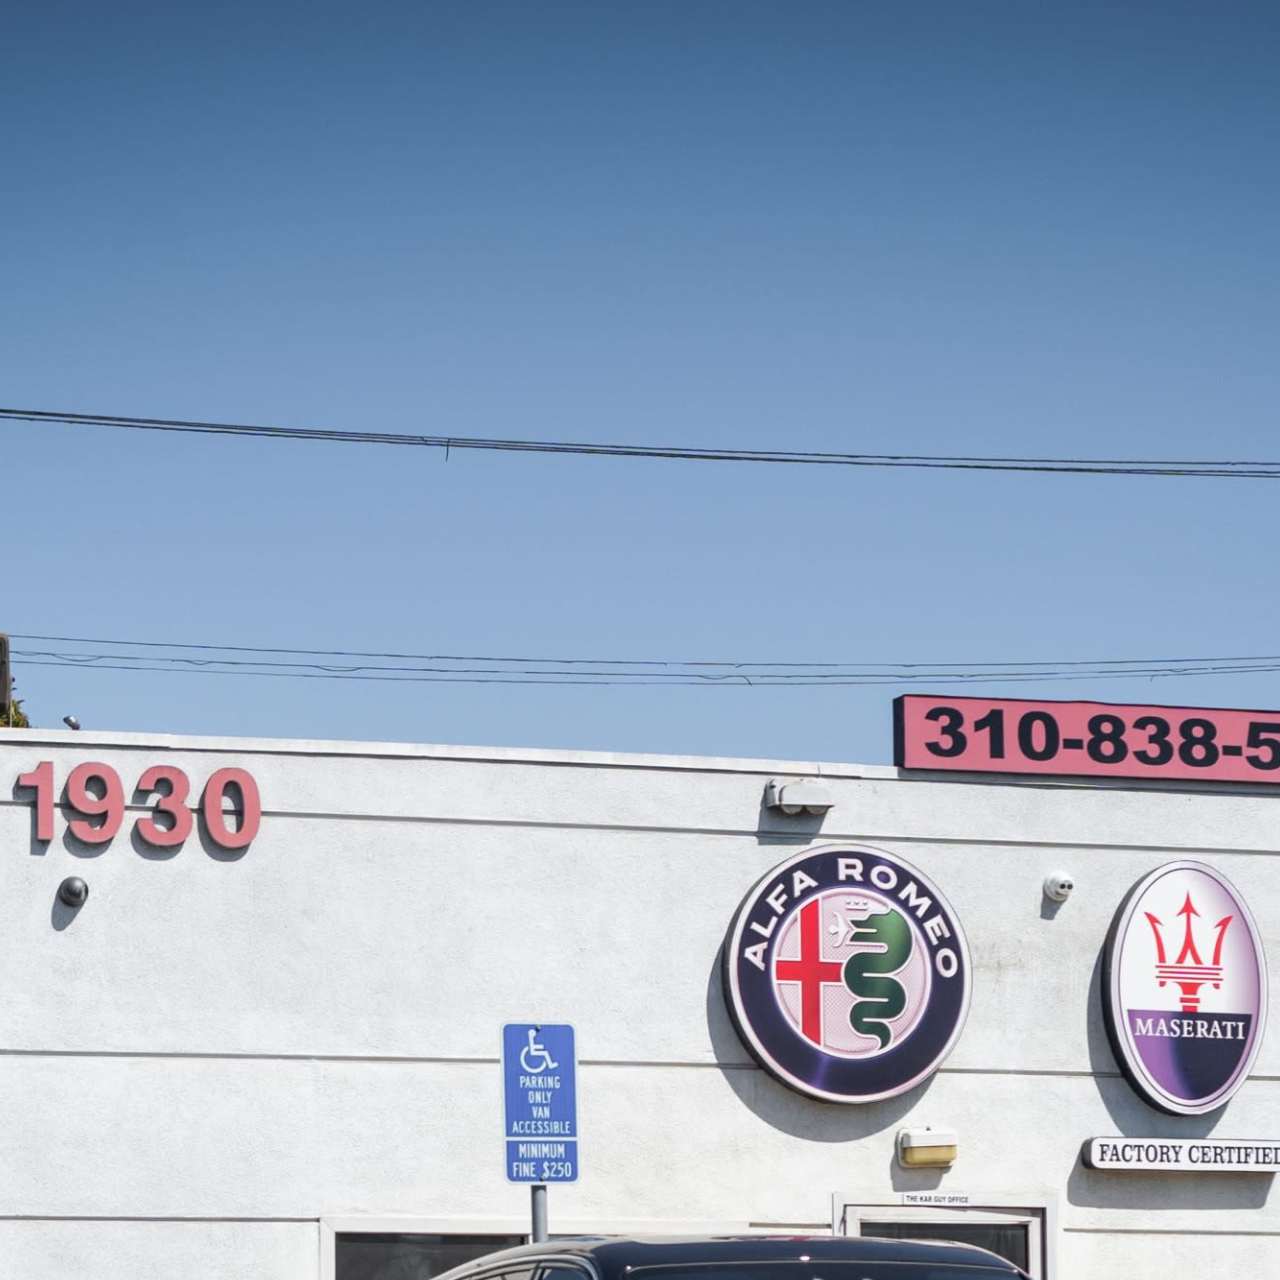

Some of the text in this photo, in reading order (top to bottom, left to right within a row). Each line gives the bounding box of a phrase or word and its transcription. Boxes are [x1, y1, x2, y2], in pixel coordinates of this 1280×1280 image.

[19, 760, 261, 849] 1930
[744, 857, 958, 978] ALFA ROMEO
[1134, 1018, 1246, 1040] MASERATI
[519, 1076, 561, 1089] PARKING
[528, 1091, 552, 1103] ONLY
[532, 1106, 550, 1119] VAN
[512, 1121, 571, 1134] ACCESSIBLE
[518, 1143, 566, 1159] MINIMUM
[1099, 1144, 1183, 1163] FACTORY
[512, 1161, 572, 1178] FINE $250
